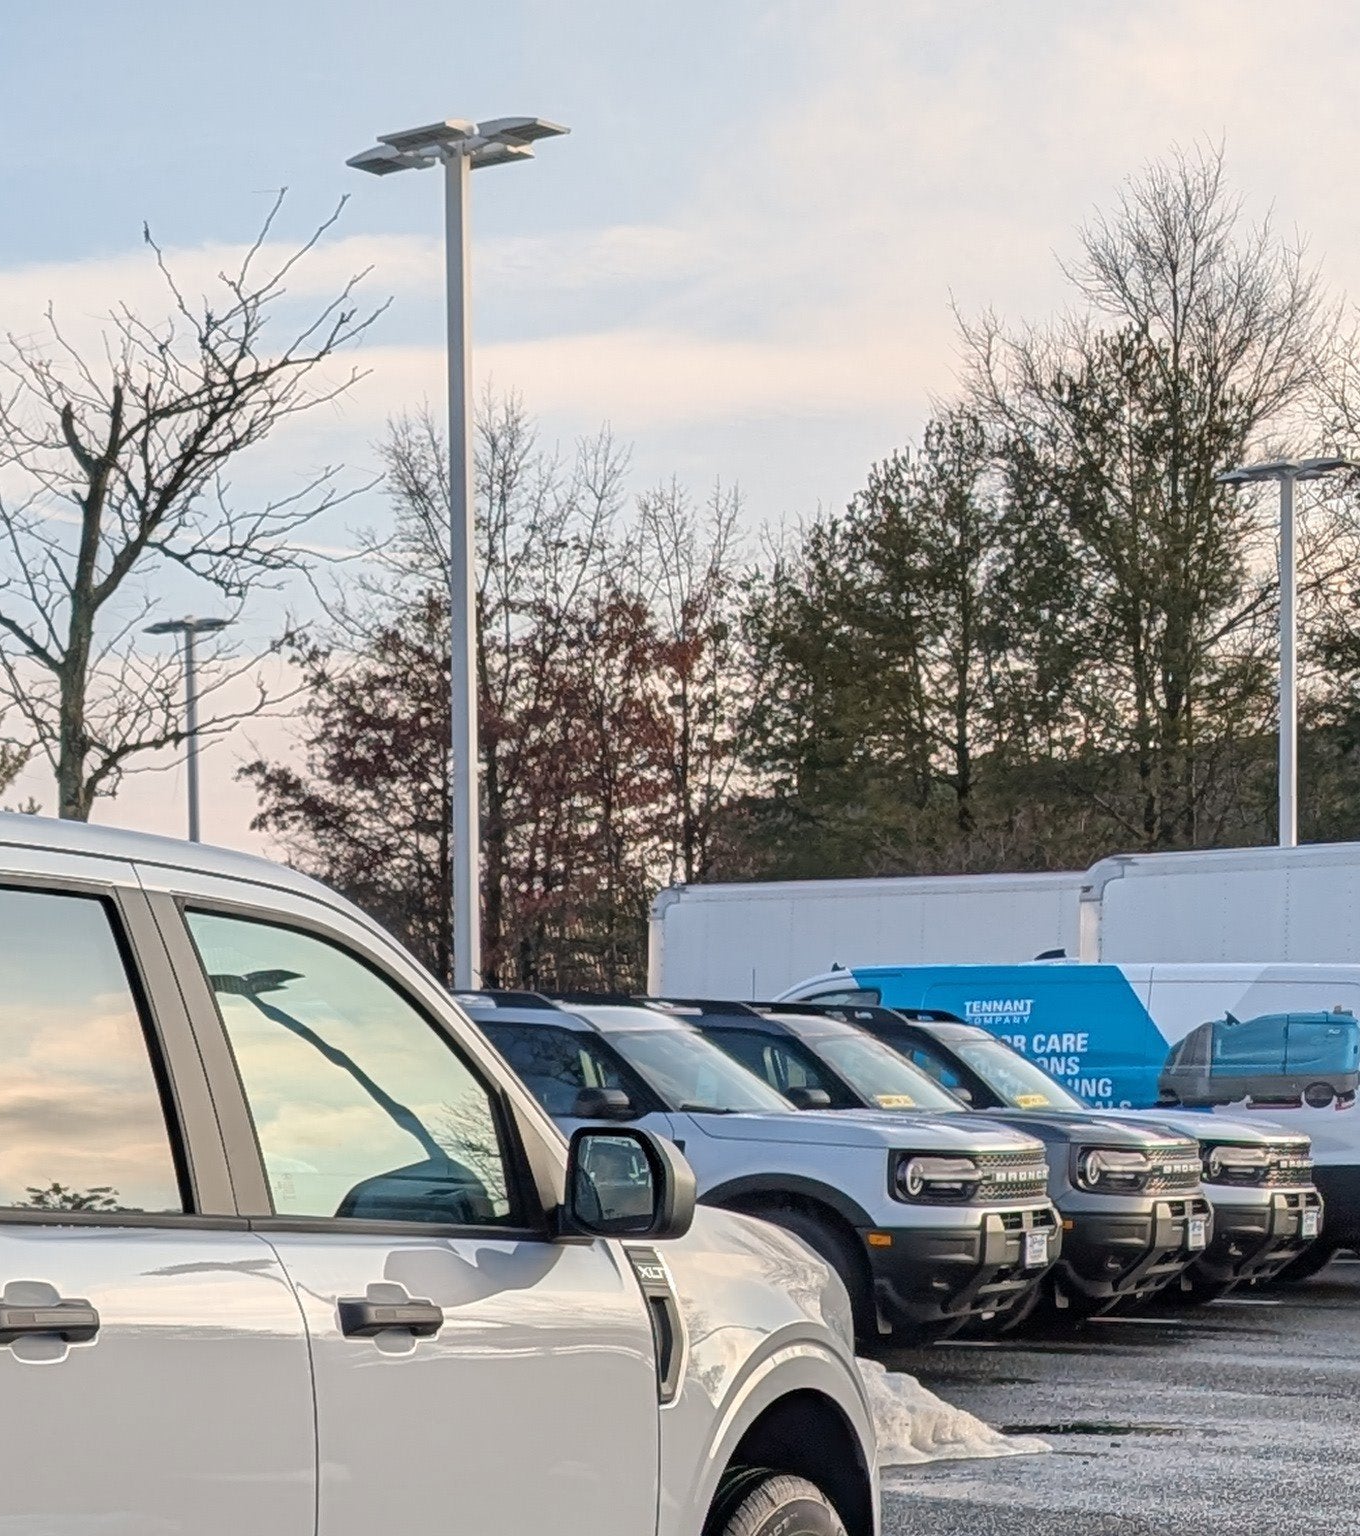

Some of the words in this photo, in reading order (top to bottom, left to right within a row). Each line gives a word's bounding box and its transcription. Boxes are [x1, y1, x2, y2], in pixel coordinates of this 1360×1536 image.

[964, 999, 1033, 1016] TENNANT
[1032, 1033, 1089, 1053] CARE
[638, 1265, 665, 1279] XLT
